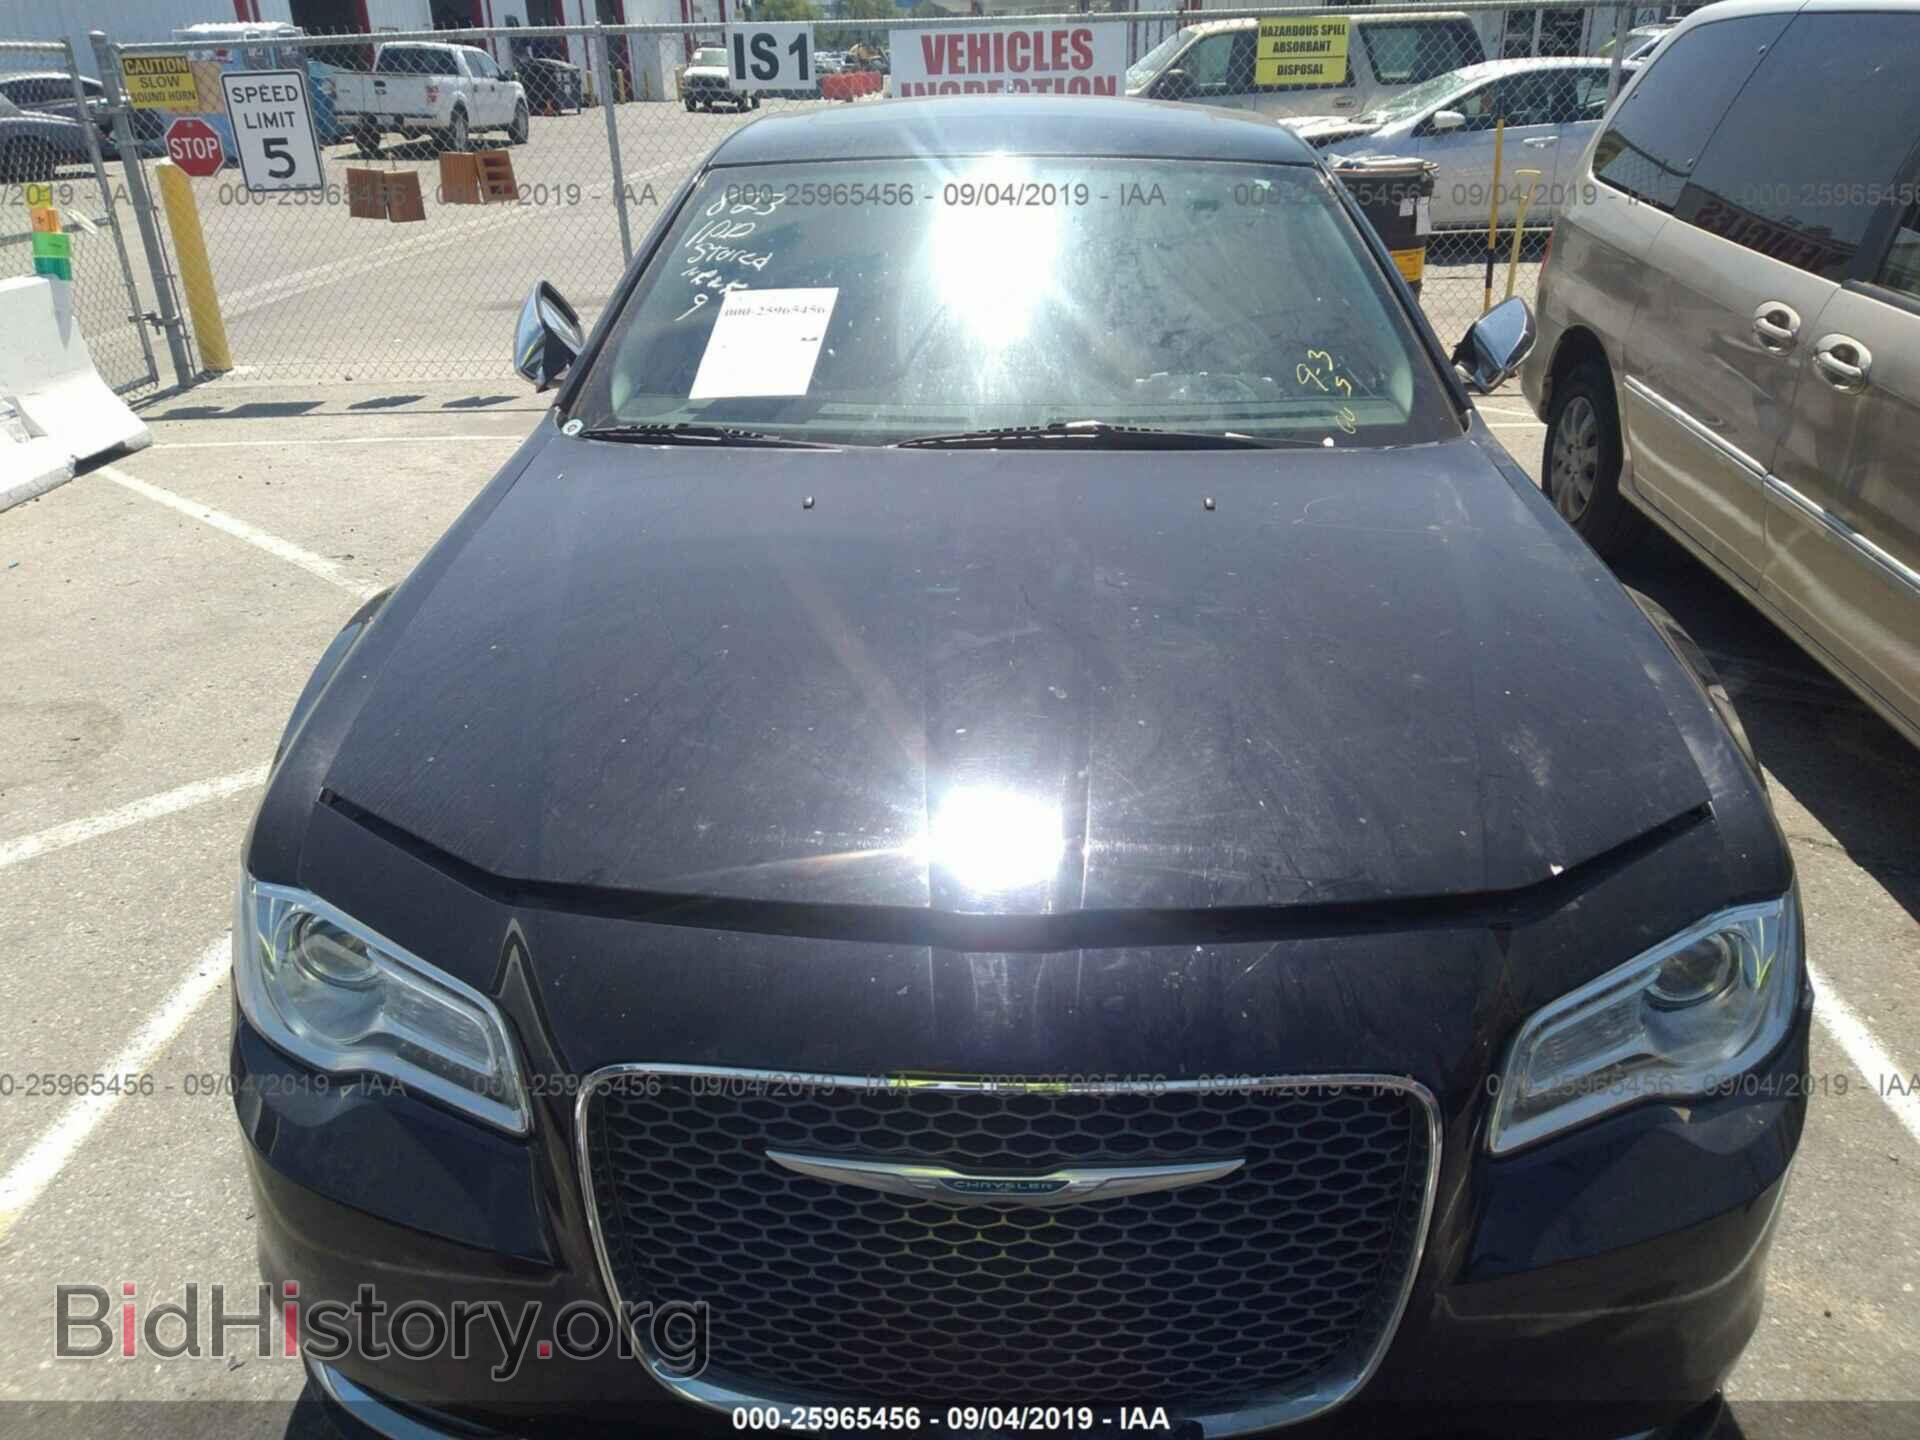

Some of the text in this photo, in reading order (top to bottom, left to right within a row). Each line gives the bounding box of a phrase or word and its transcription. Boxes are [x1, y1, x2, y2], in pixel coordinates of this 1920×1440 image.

[1261, 24, 1346, 37] HAZARDOUS SPILL
[921, 28, 1094, 76] VEHICLES
[1272, 40, 1332, 53] ABSORBANT
[733, 32, 809, 81] IS 1
[125, 58, 190, 74] CAUTION
[1276, 63, 1324, 76] DISPOSAL
[139, 75, 180, 89] SLOW
[168, 89, 196, 102] HORN
[232, 84, 298, 104] SPEED
[244, 111, 296, 129] LIMIT
[170, 138, 218, 160] STOP
[262, 137, 297, 179] 5
[953, 1180, 1054, 1190] CHRYSLER
